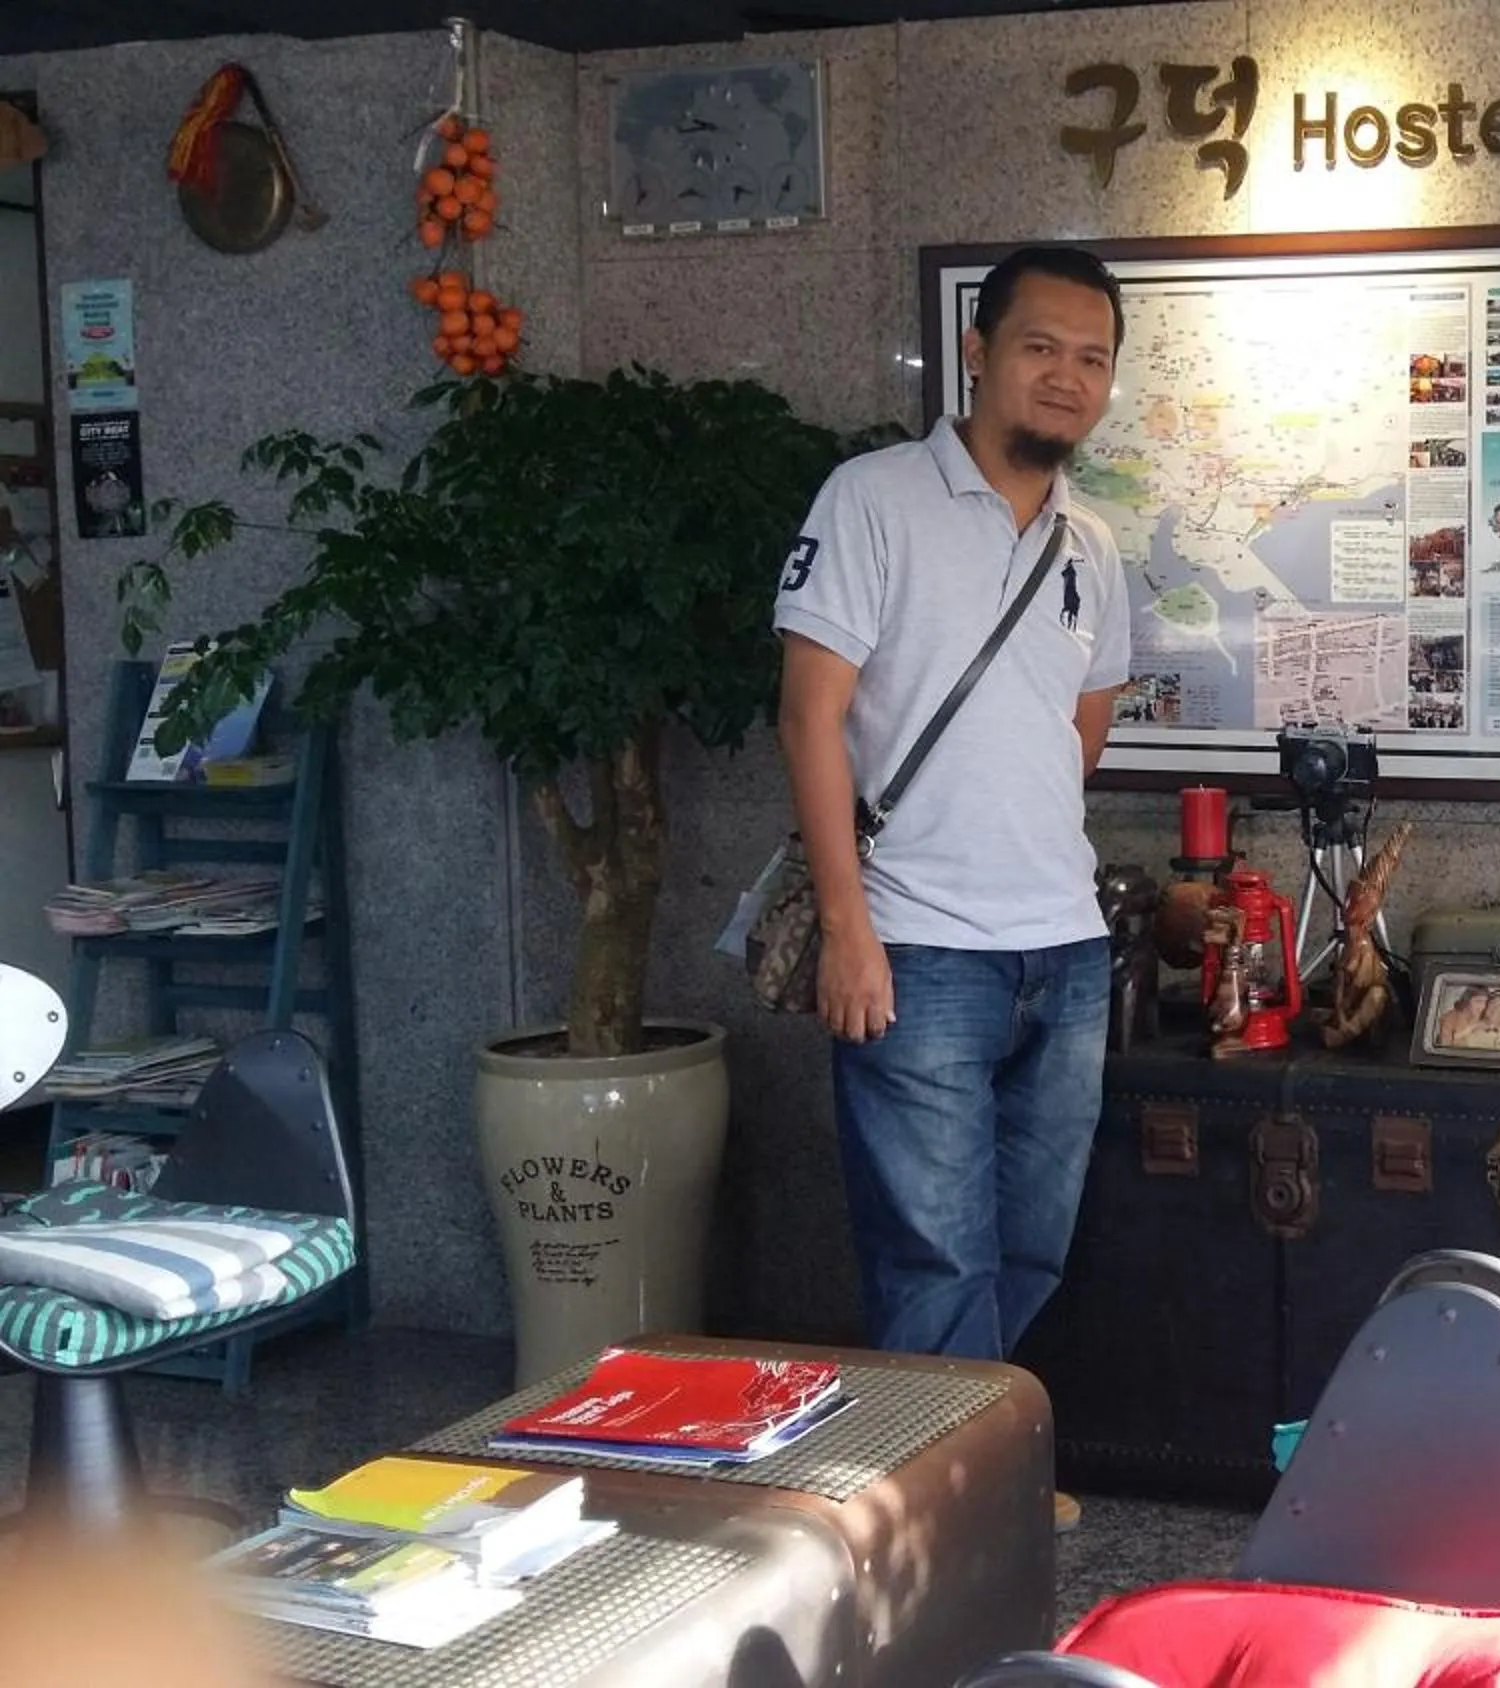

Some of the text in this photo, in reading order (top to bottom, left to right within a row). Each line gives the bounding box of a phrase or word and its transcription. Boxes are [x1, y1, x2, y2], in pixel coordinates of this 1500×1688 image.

[782, 535, 819, 591] 3
[501, 1157, 631, 1195] FLOWERS
[550, 1181, 566, 1202] &
[518, 1201, 614, 1222] PLANTS
